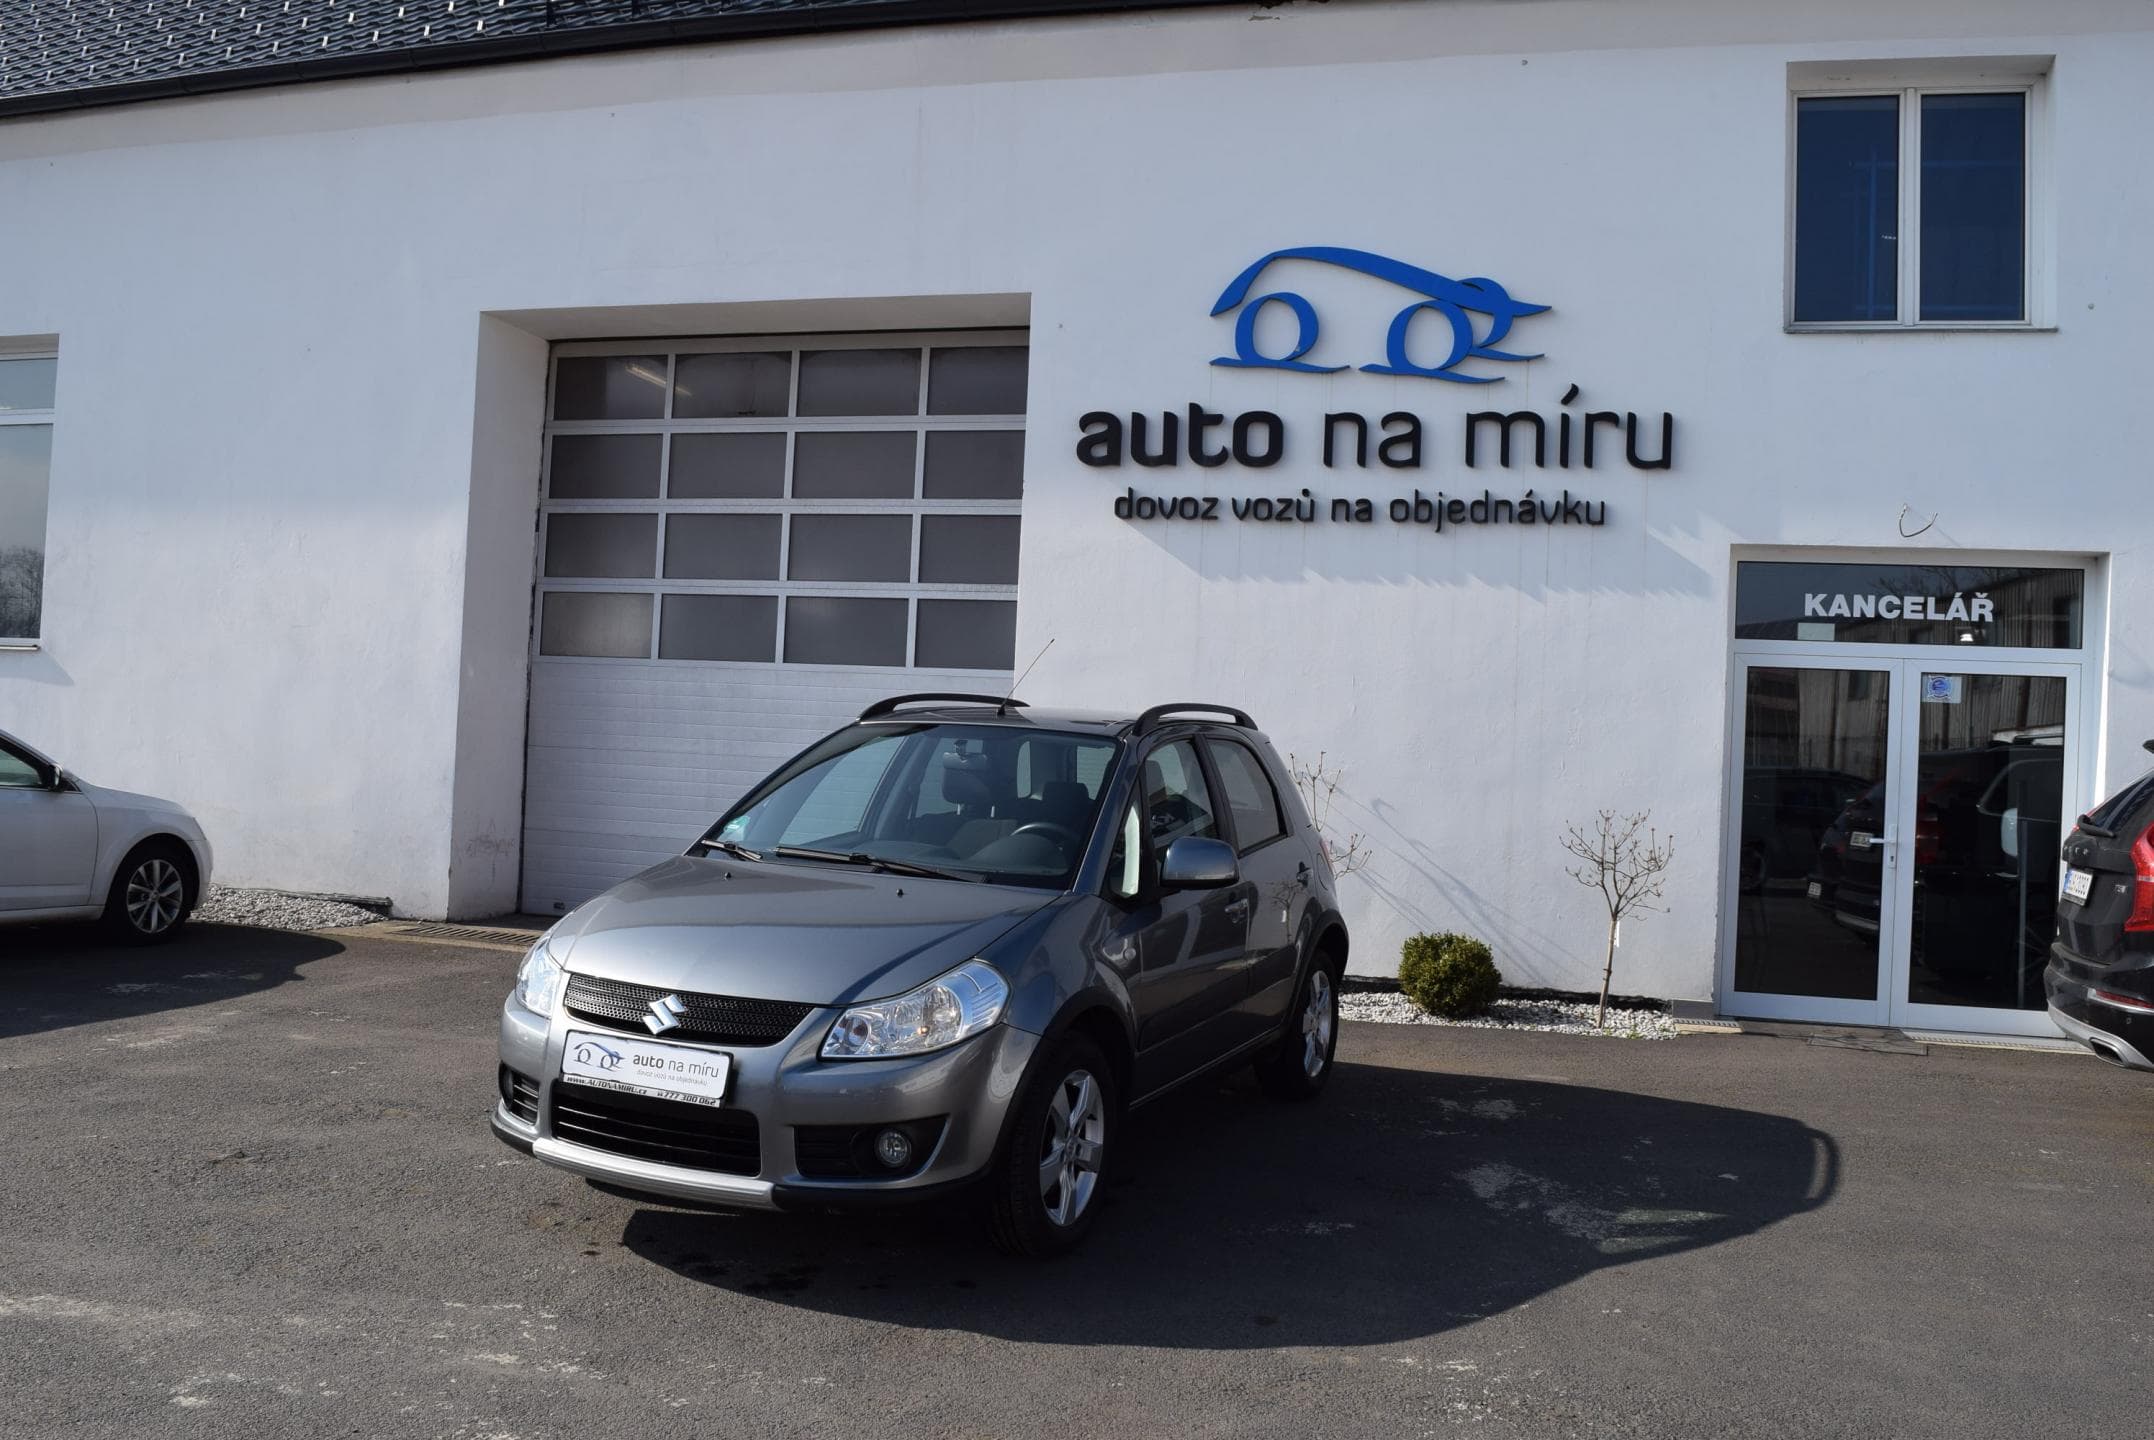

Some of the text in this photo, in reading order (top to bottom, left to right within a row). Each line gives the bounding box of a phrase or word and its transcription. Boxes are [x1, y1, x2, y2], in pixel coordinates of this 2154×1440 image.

[1076, 383, 1674, 471] auto na míru
[1114, 486, 1606, 534] dovoz vozů na objednávku
[1803, 592, 1995, 624] KANCELÁŘ
[633, 1054, 719, 1078] auto na míru
